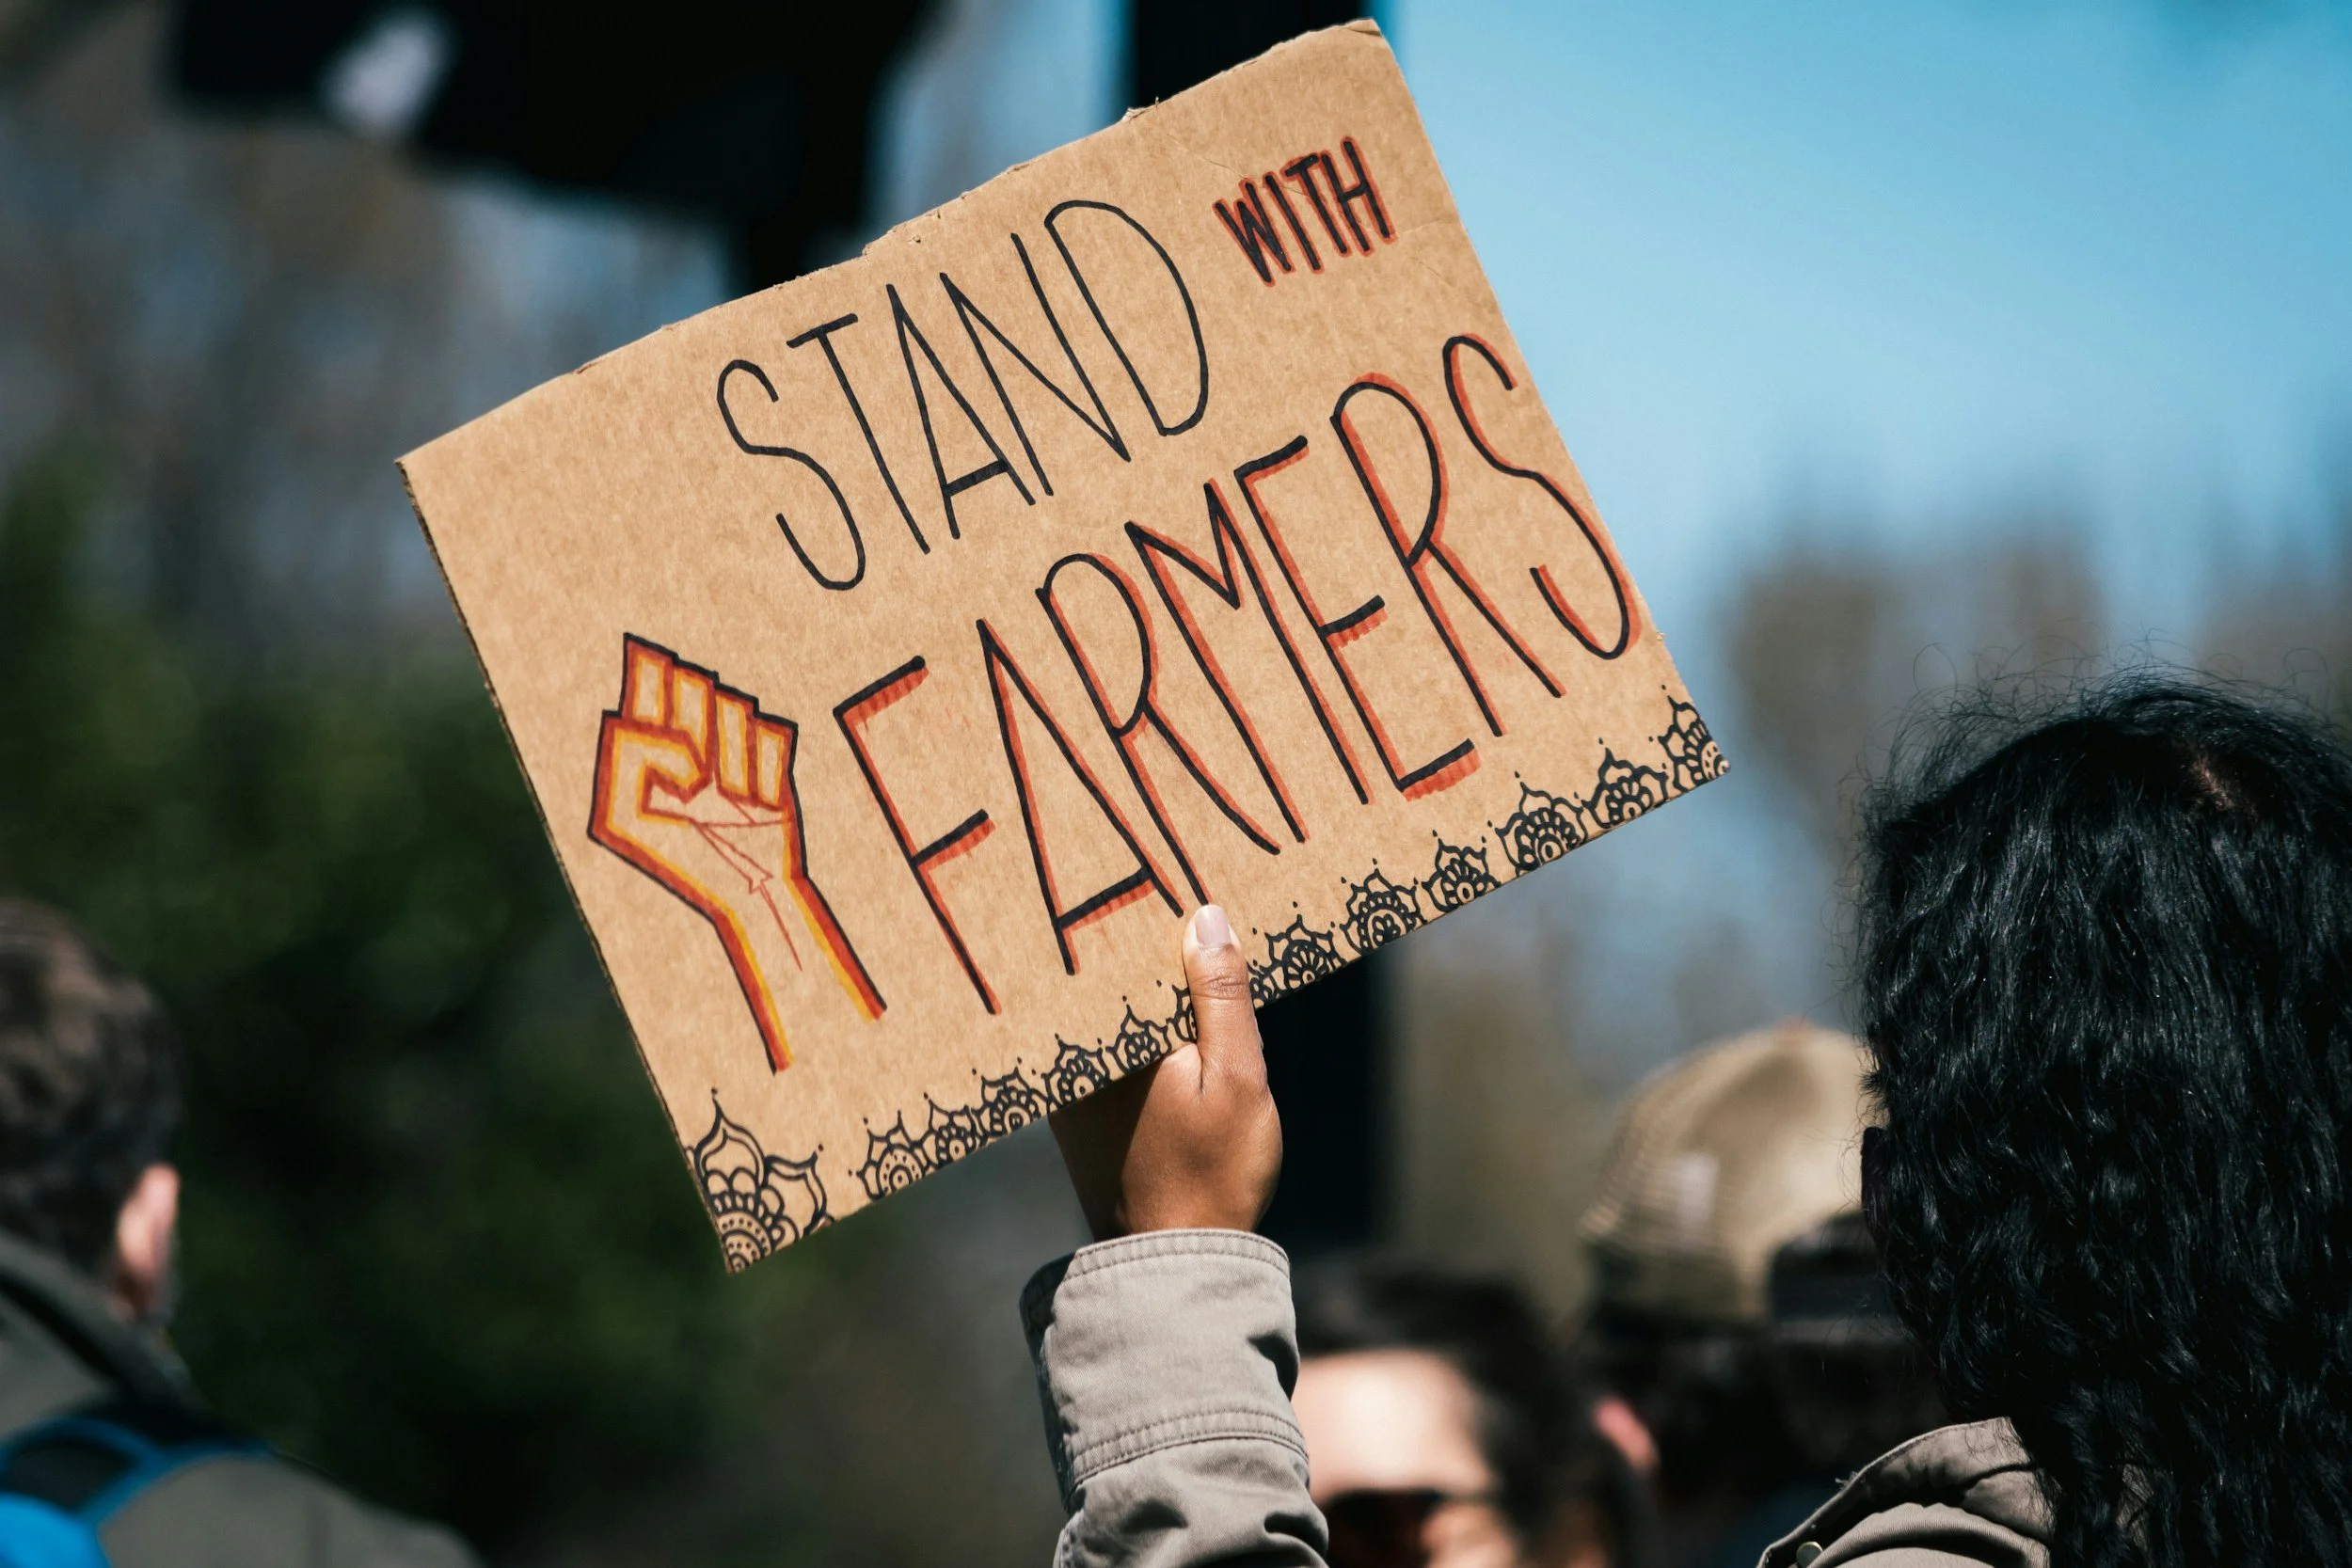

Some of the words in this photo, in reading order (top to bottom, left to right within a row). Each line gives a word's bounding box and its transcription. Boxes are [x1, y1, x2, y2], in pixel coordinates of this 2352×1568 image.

[718, 199, 1211, 591] STAND
[1214, 139, 1395, 284] WITH
[833, 334, 1638, 1015] FARMERS
